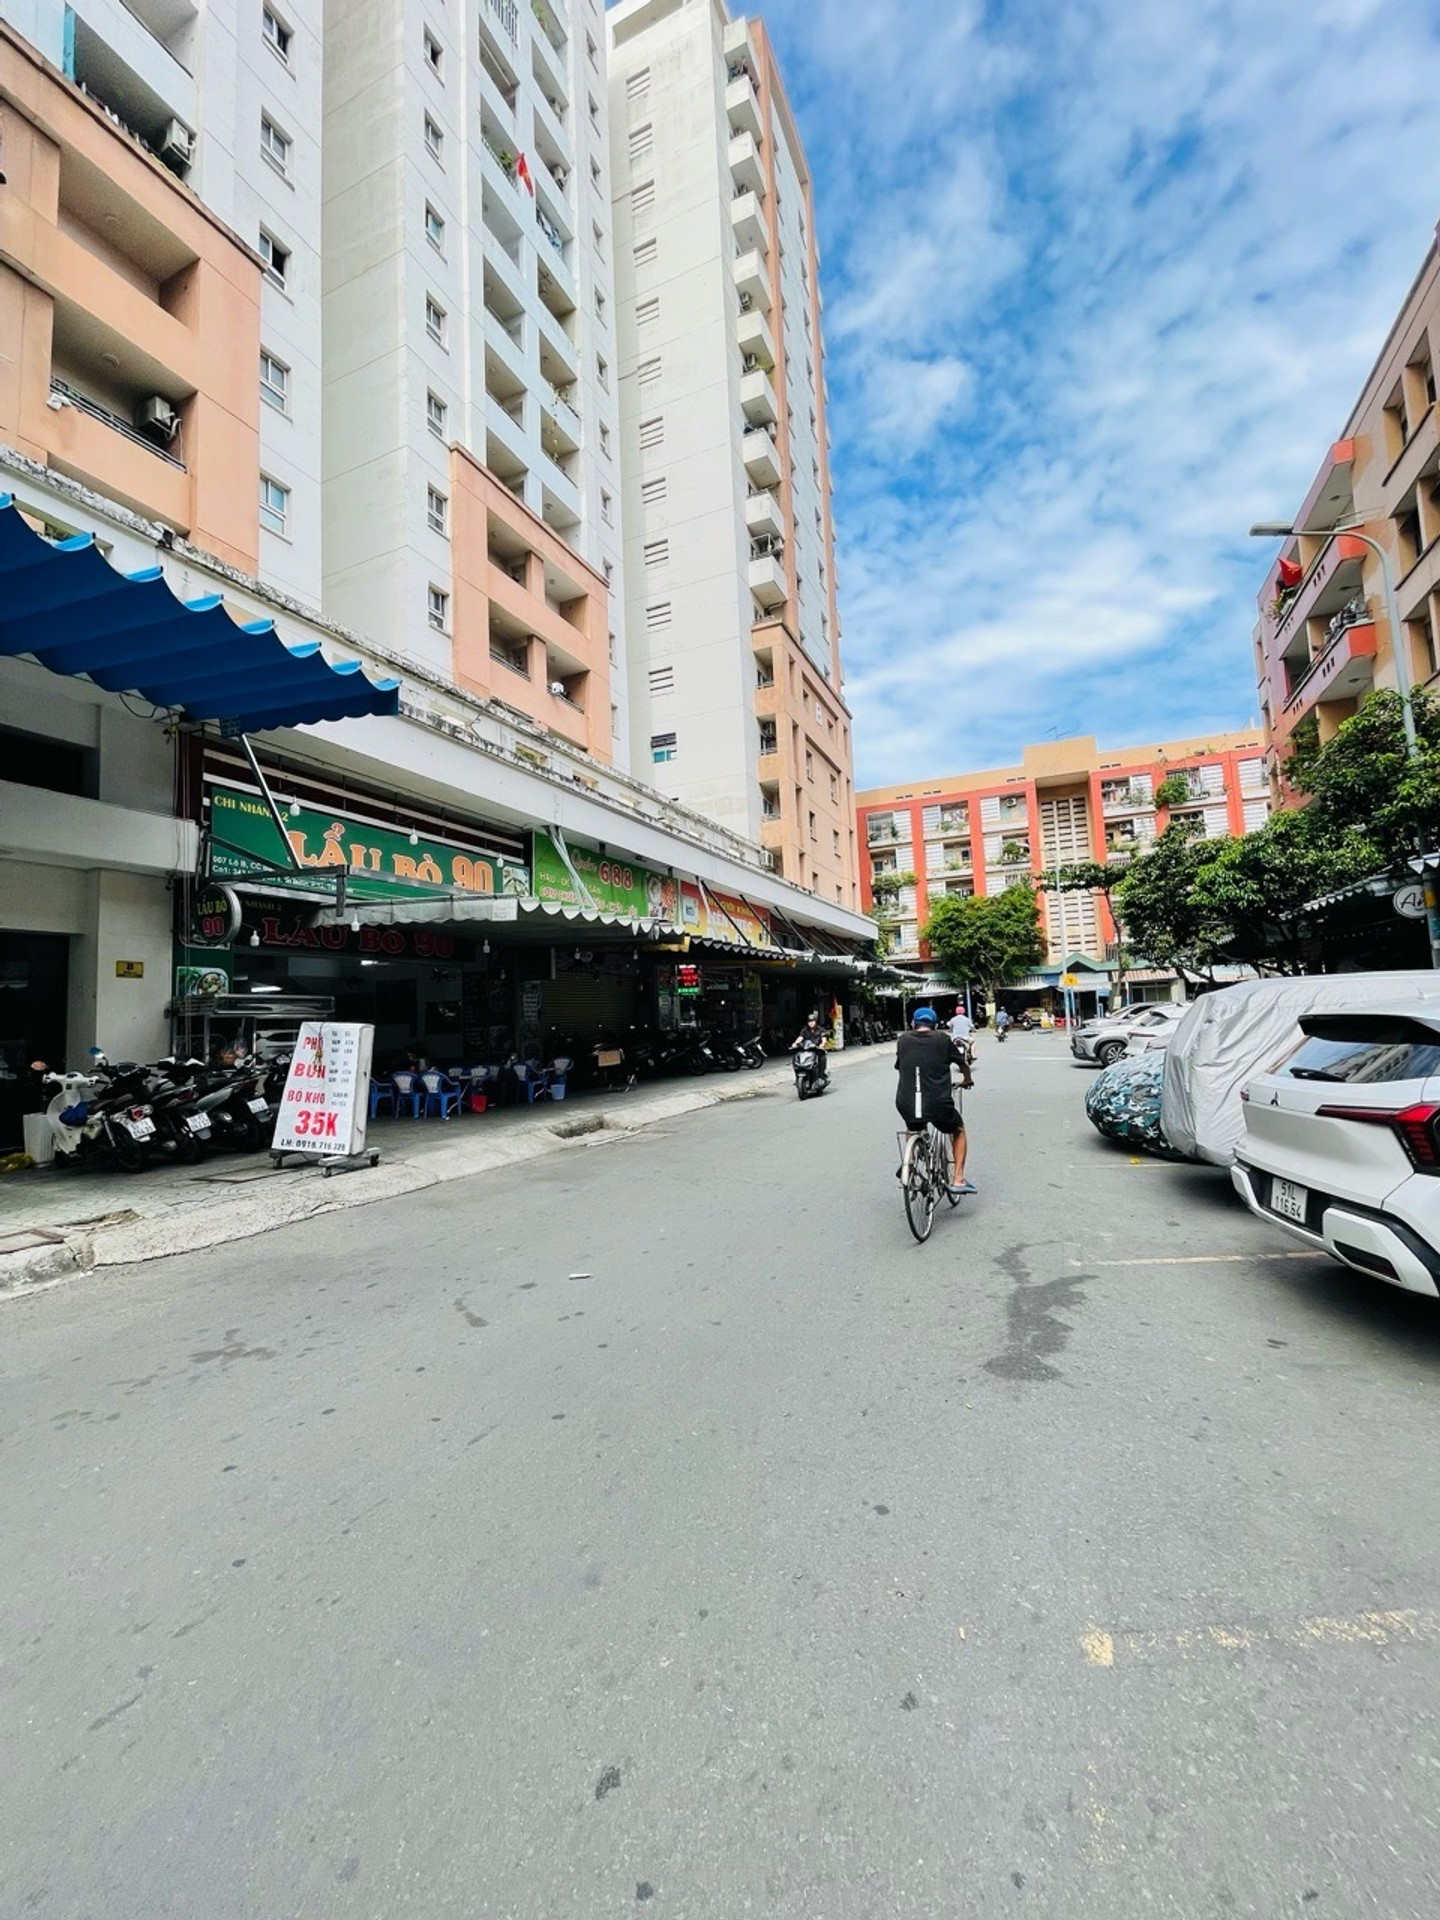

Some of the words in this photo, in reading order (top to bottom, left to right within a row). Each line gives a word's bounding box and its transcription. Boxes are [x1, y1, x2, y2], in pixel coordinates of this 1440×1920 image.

[214, 795, 236, 809] CHI
[281, 811, 289, 822] 2
[392, 853, 443, 885] BÒ
[452, 855, 494, 894] 90
[600, 861, 633, 891] 688
[202, 916, 225, 937] 90
[294, 1110, 339, 1137] 35K
[1281, 1181, 1297, 1200] 51L
